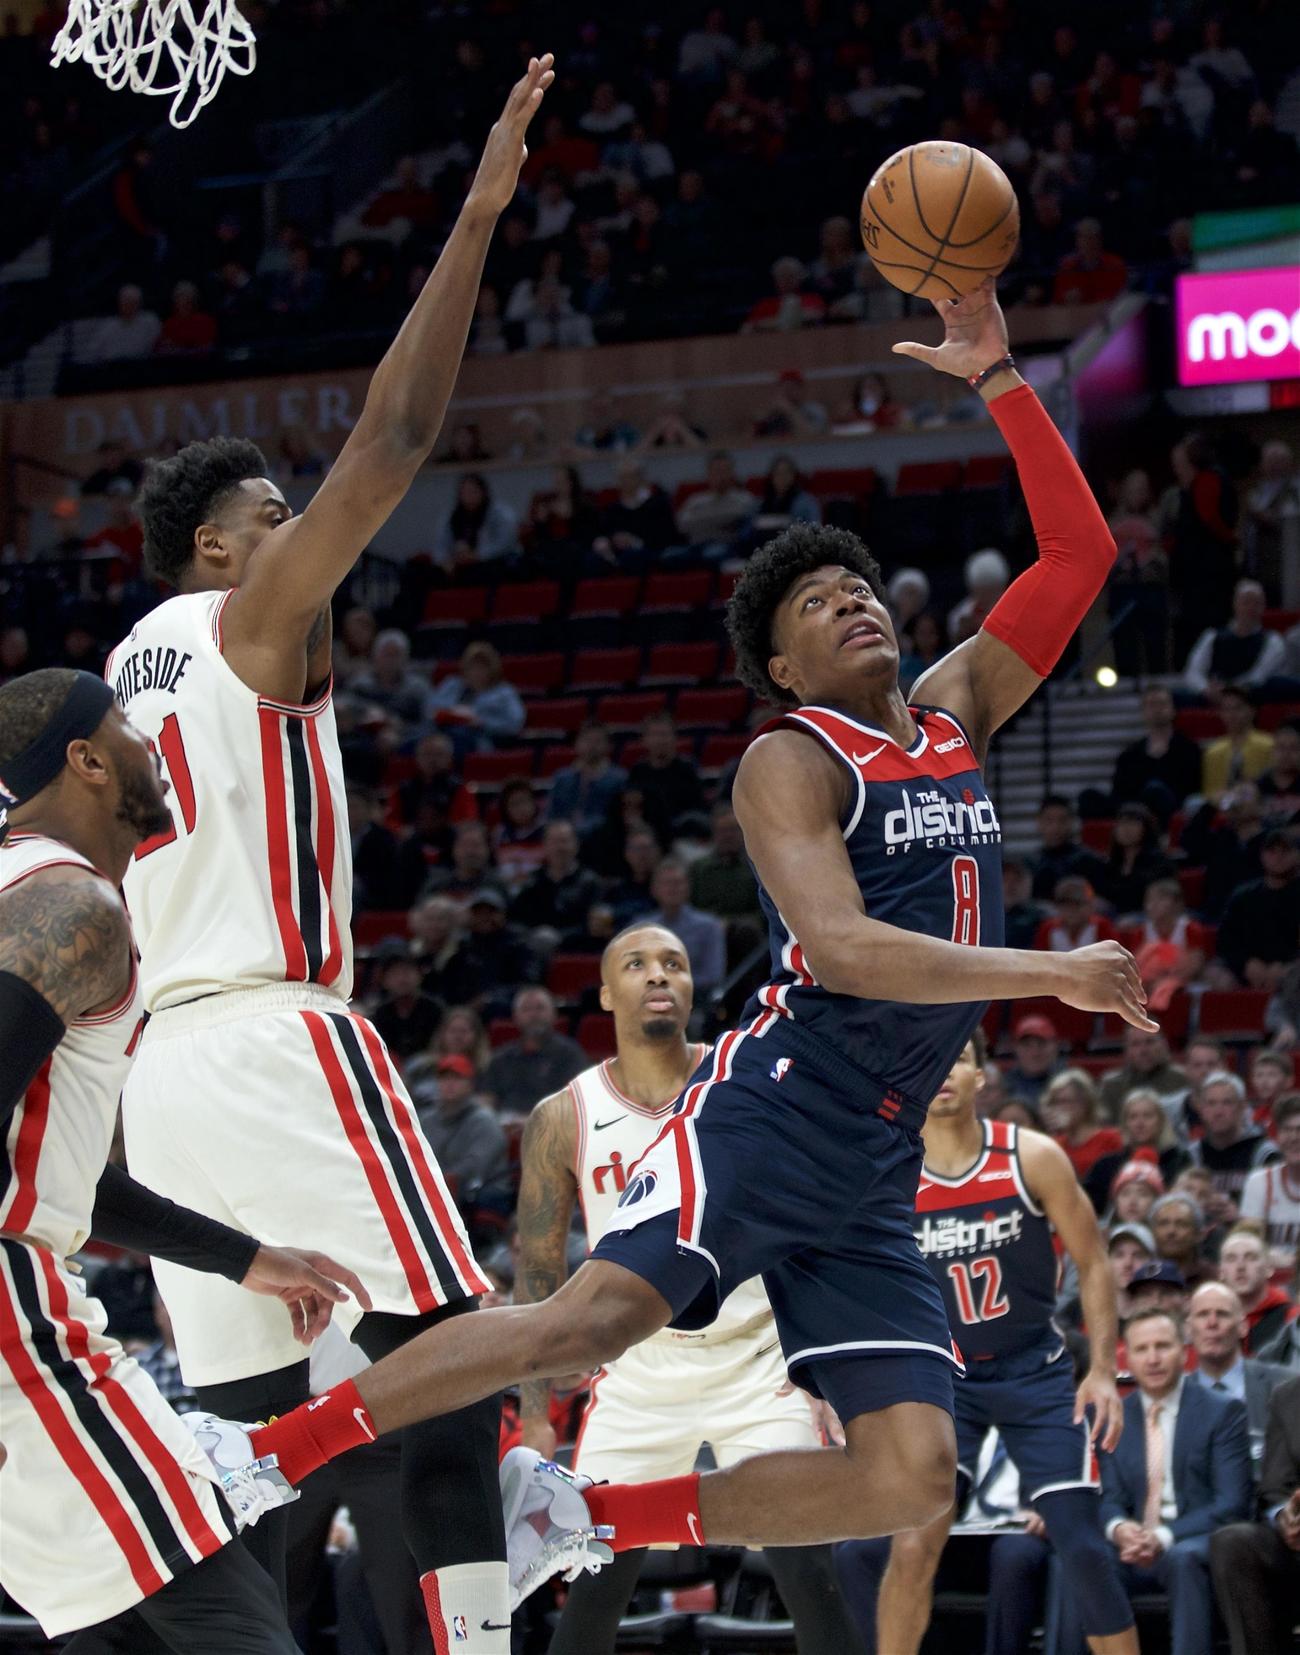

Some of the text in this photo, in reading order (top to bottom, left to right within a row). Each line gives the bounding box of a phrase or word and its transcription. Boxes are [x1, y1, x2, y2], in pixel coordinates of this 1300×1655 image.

[1187, 308, 1300, 362] mo
[63, 387, 358, 453] DAIMLER
[115, 647, 193, 708] HITESIDE
[884, 788, 1001, 845] district
[916, 790, 939, 804] THE
[886, 842, 911, 856] OF
[952, 855, 980, 947] 8
[914, 1209, 1024, 1254] district
[936, 1217, 957, 1230] THE
[947, 1255, 1011, 1326] 12
